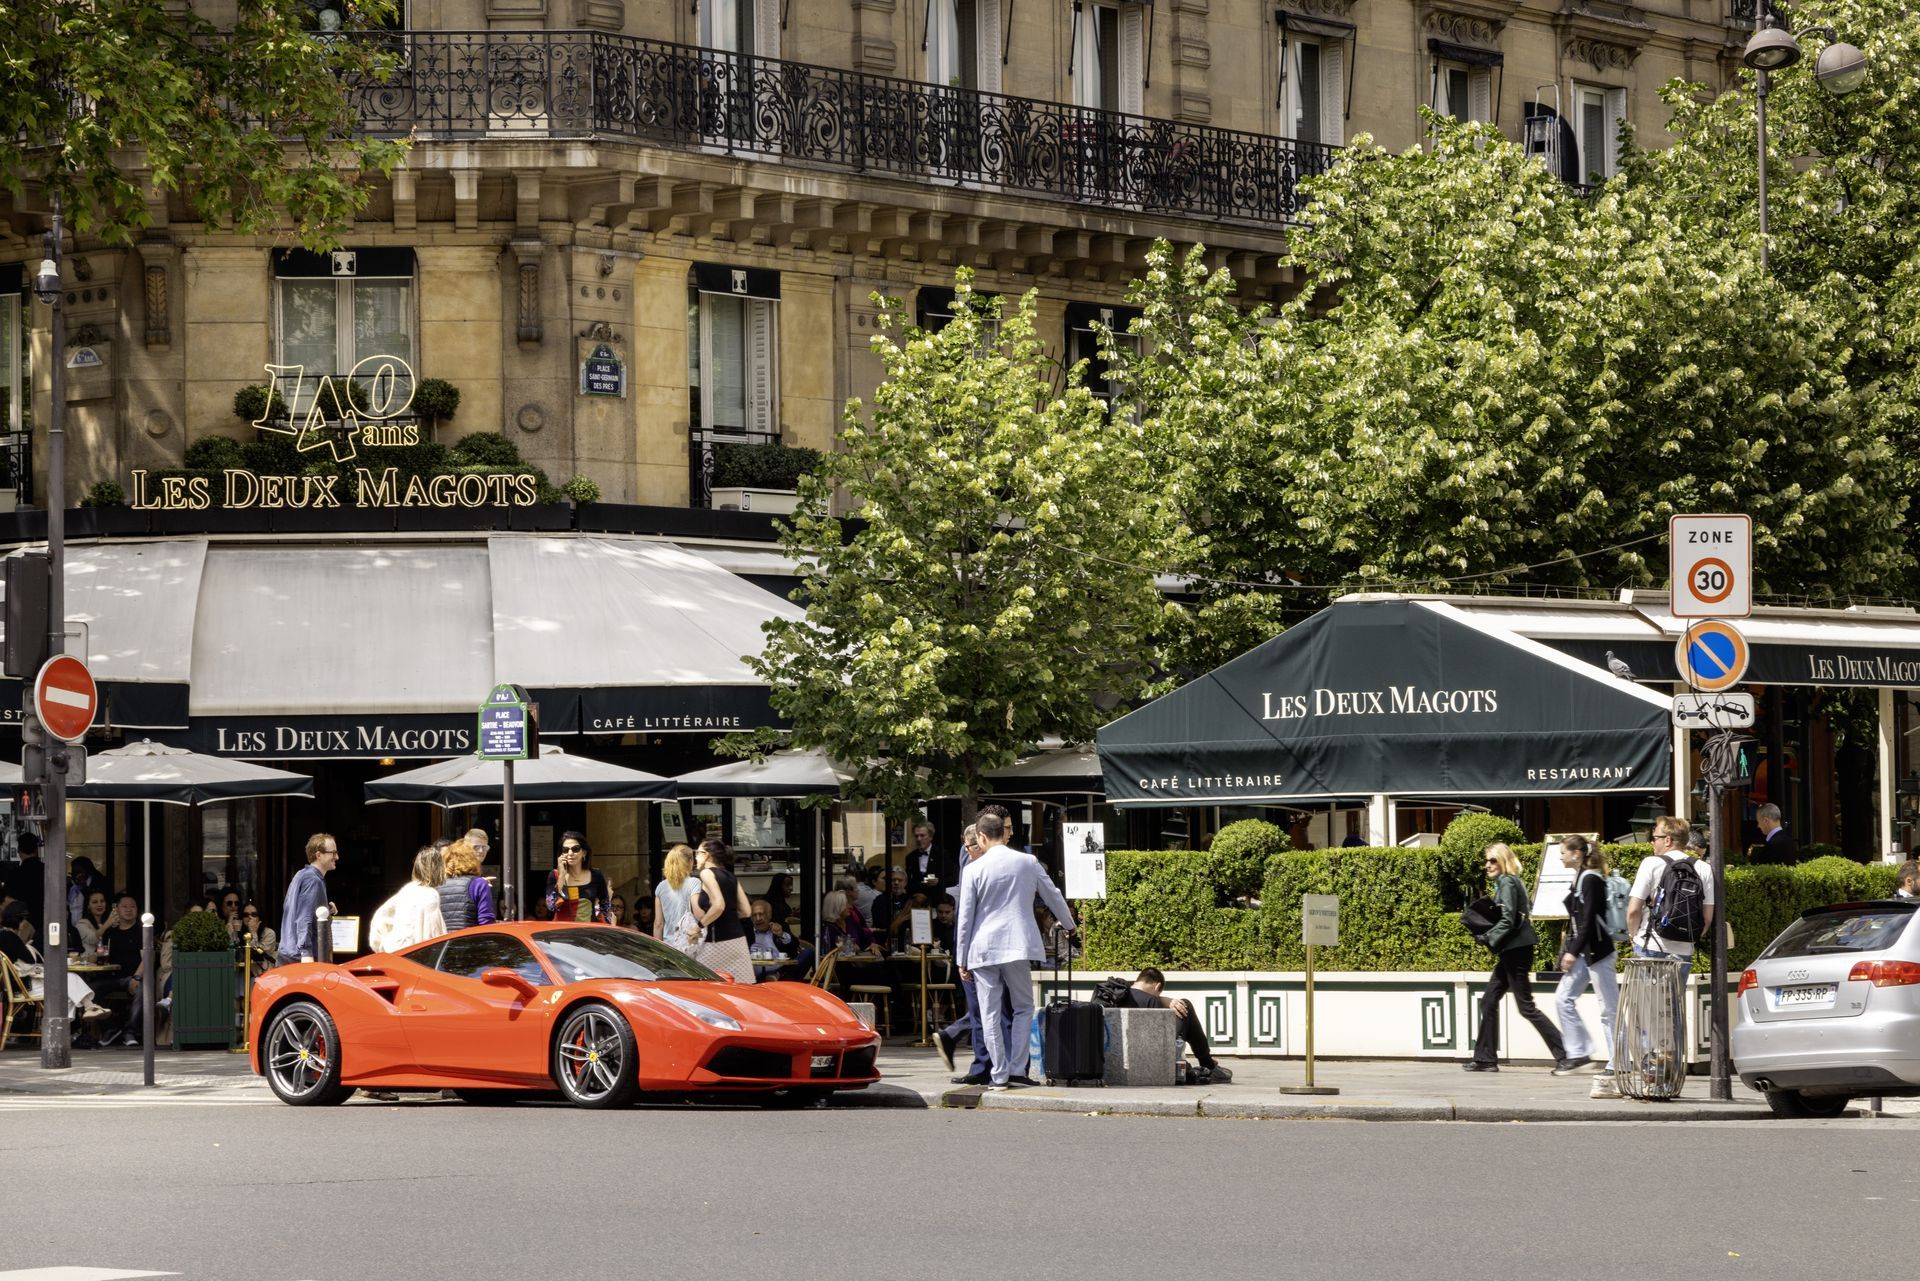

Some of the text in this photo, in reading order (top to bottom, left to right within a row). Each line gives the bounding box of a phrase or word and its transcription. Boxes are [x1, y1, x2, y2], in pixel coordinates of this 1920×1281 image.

[589, 373, 618, 382] SAINT-GERMAIN
[593, 382, 602, 390] DES
[252, 354, 416, 462] 140
[362, 423, 420, 447] ans
[131, 466, 538, 511] LES DEUX MAGOTS
[1688, 531, 1734, 544] ZONE
[1696, 570, 1725, 591] 30
[1809, 654, 1835, 680] LES
[1837, 655, 1877, 681] DEUX
[1262, 686, 1498, 720] LES DEUX MAGOTS
[495, 711, 510, 719] PLACE
[593, 714, 741, 729] CAFÉ LITTÉRAIRE
[216, 725, 470, 752] LES DEUX MAGOTS
[1139, 772, 1283, 790] CAFÉ LITTÉRAIRE
[1527, 766, 1634, 780] RESTAURANT
